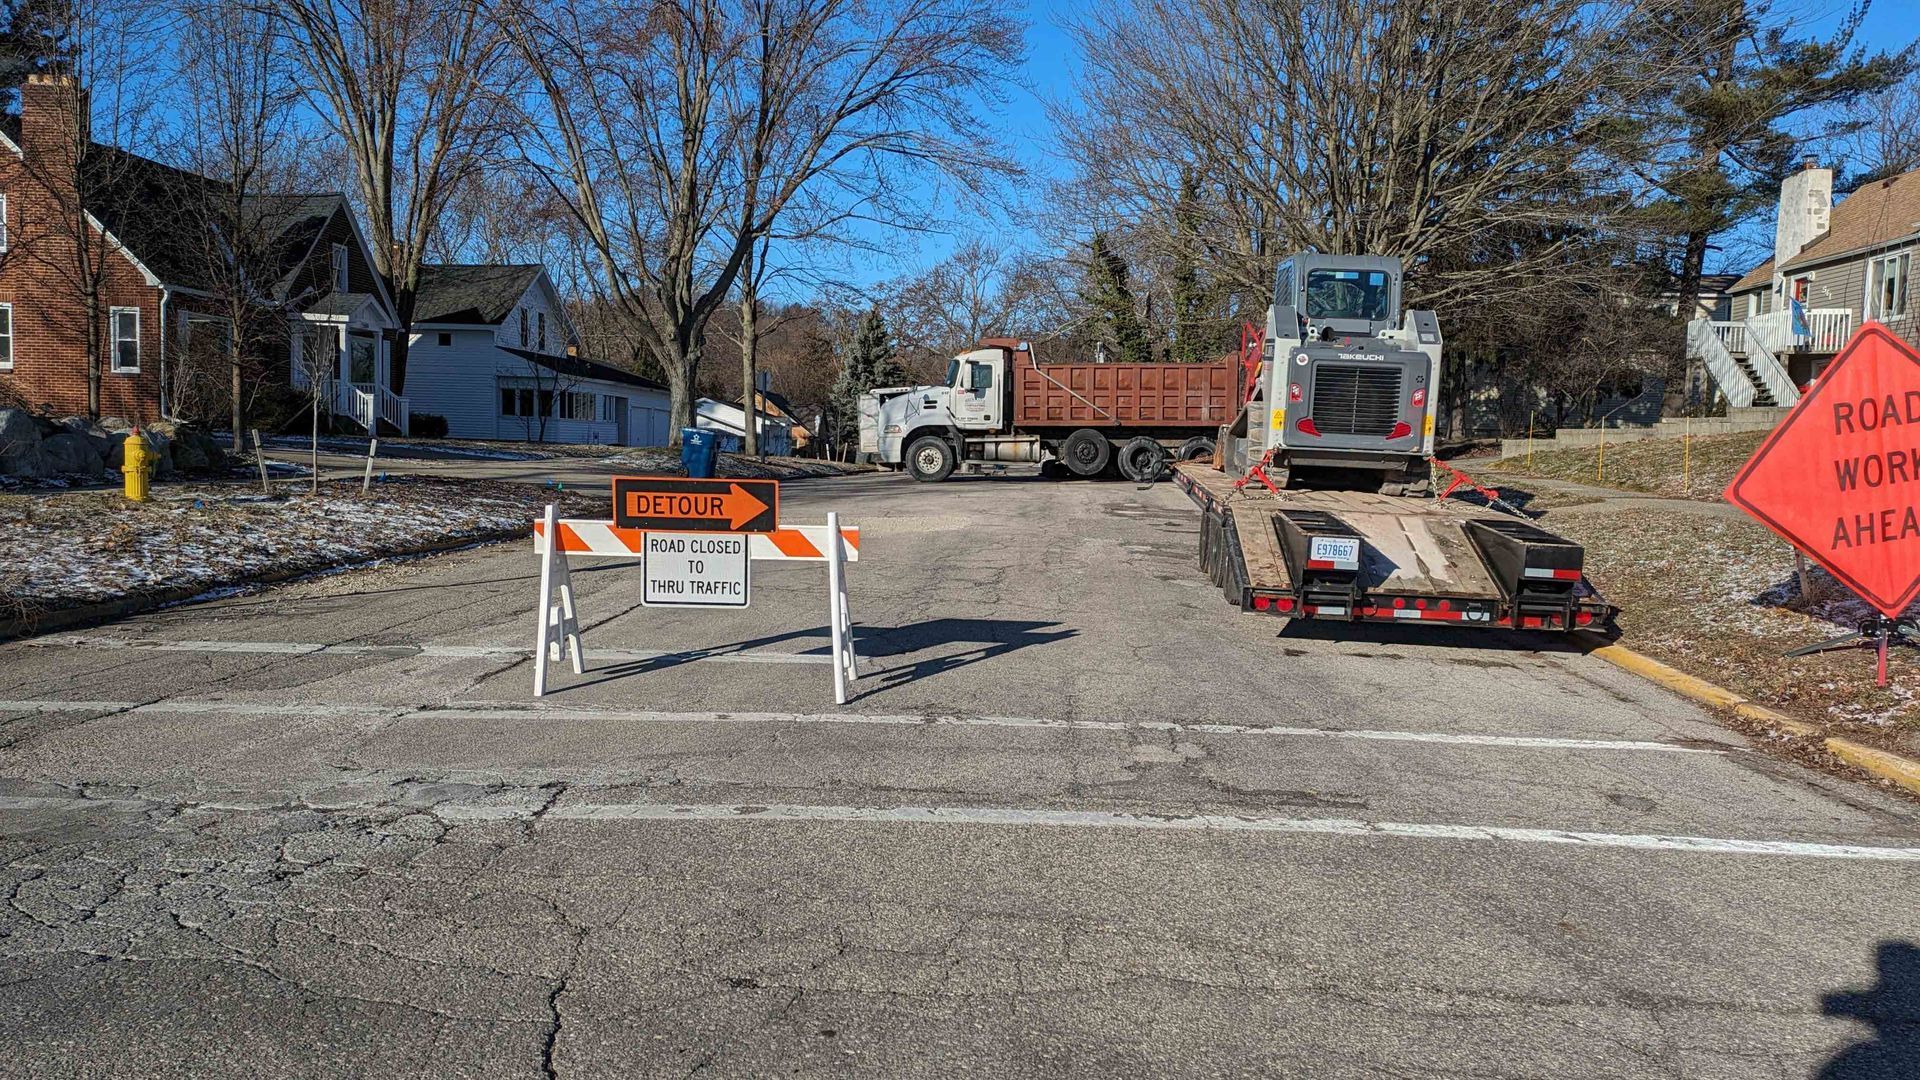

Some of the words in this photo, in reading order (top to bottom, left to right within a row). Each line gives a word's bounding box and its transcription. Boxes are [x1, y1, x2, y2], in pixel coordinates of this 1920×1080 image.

[1337, 353, 1385, 361] TAKEUCHI
[1833, 390, 1920, 435] ROAD
[637, 495, 723, 516] DETOUR
[1831, 506, 1920, 551] AHEA
[651, 539, 685, 553] ROAD
[691, 540, 741, 554] CLOSED
[1317, 543, 1354, 557] E978667
[688, 560, 704, 574] TO
[651, 580, 684, 594] THRU
[690, 581, 741, 595] TRAFFIC
